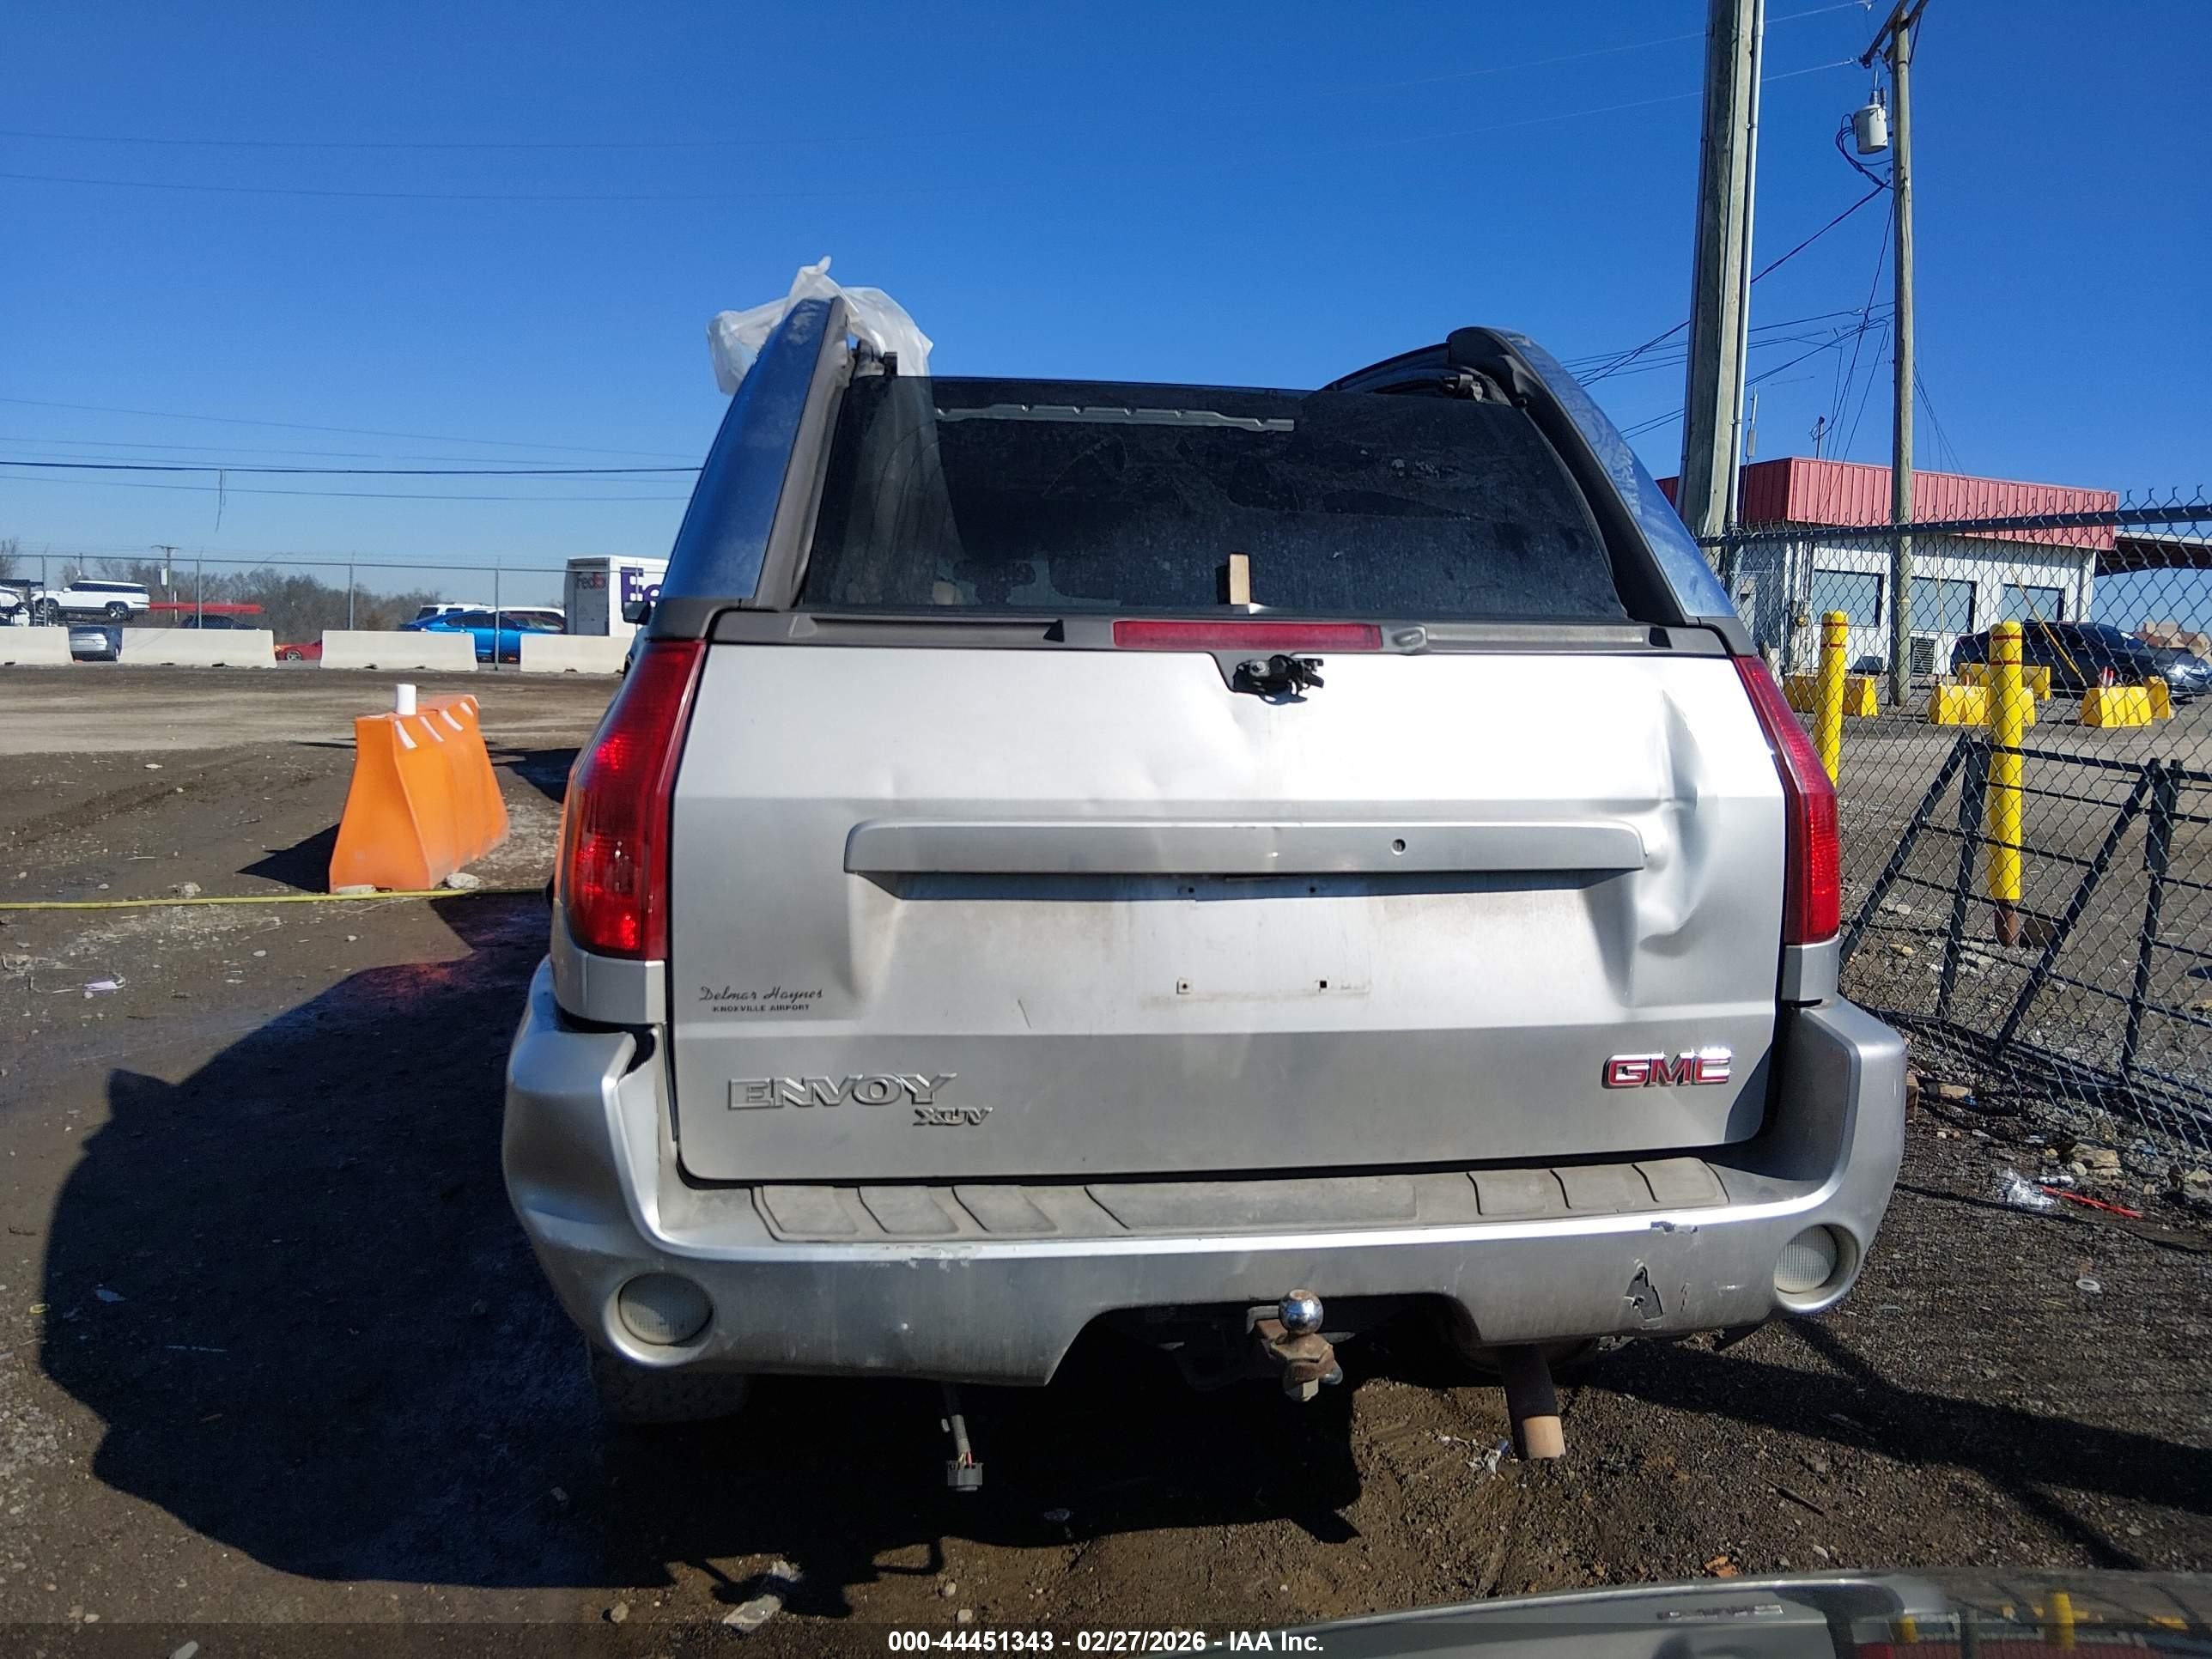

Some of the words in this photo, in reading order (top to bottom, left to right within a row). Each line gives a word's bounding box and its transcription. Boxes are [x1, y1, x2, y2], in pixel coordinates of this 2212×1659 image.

[699, 986, 757, 1001] Delmar
[763, 986, 824, 1004] Haynes
[1601, 1046, 1733, 1089] GMC
[727, 1072, 957, 1110] ENVOY
[912, 1106, 994, 1127] XUV
